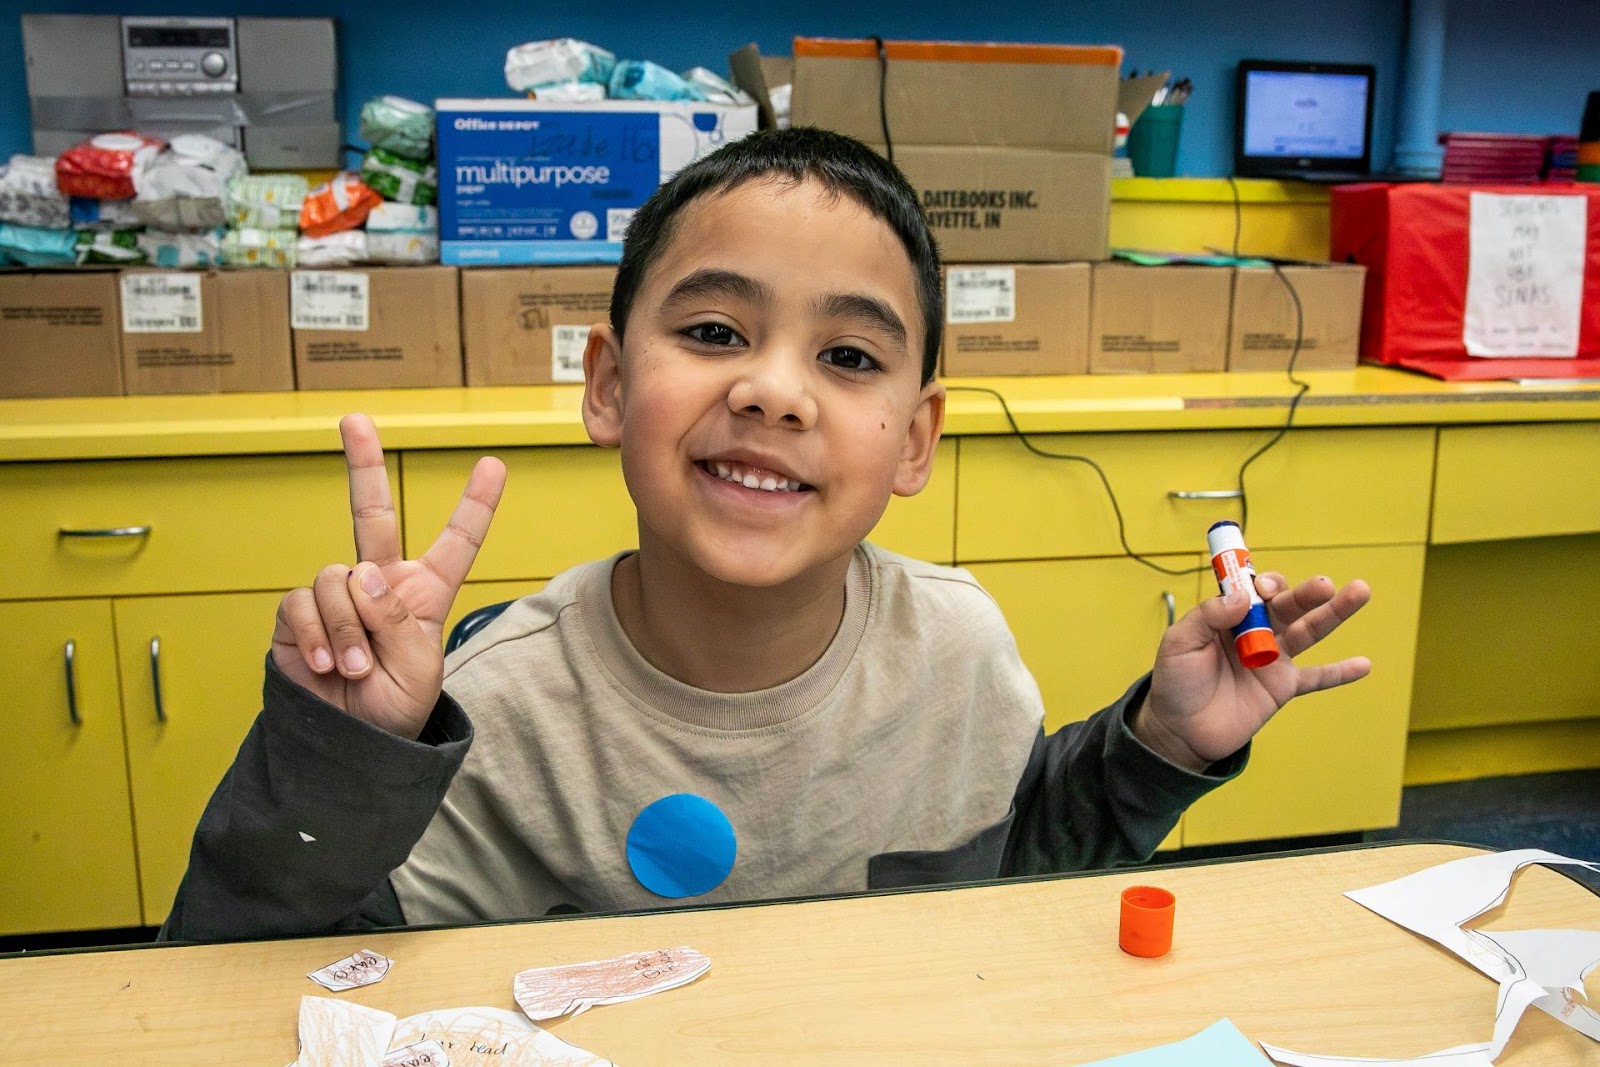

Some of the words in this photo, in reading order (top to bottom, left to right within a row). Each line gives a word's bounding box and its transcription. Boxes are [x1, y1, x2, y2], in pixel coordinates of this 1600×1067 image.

[454, 117, 497, 131] Office
[498, 120, 540, 131] DEPOT
[456, 161, 610, 188] multipurpose
[923, 189, 1005, 209] DATEBOOKS
[1009, 189, 1038, 209] INC.
[985, 211, 1001, 229] IN
